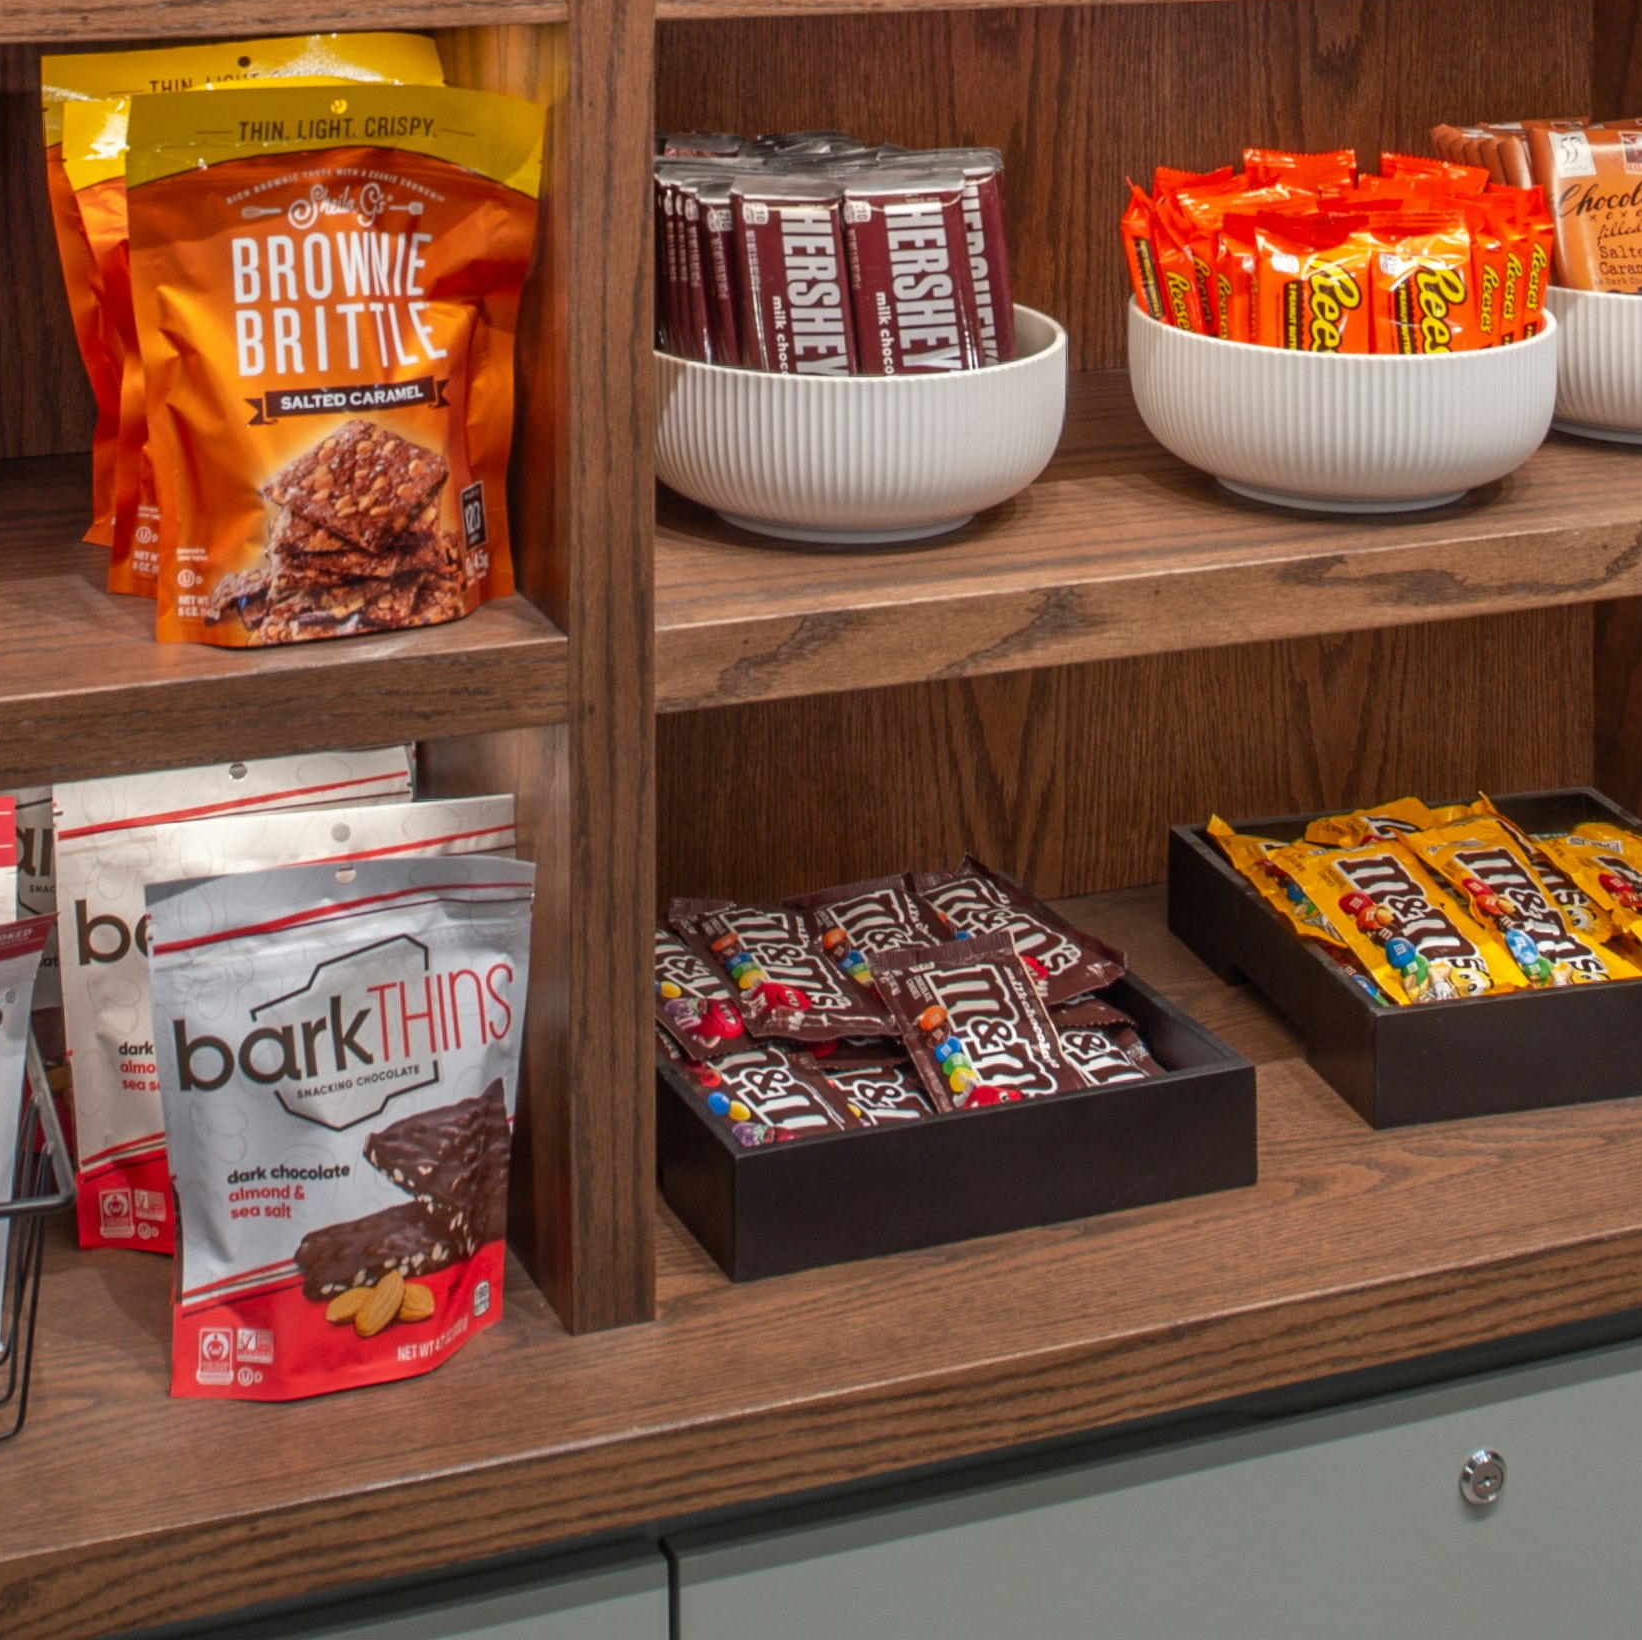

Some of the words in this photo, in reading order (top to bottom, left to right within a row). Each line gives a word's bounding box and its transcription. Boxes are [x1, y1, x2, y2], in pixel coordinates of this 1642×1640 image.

[238, 121, 291, 143] THIN.
[298, 118, 358, 141] LIGHT.
[365, 117, 438, 139] CRISPY.
[231, 232, 433, 304] BROWNIE
[1526, 242, 1547, 312] Reese's
[772, 295, 785, 328] milk
[875, 291, 887, 326] milk
[235, 302, 448, 377] BRITTLE
[280, 391, 348, 411] SALTED
[349, 384, 425, 407] CARAMEL
[118, 1040, 154, 1057] dark
[296, 1077, 354, 1100] SNACKING
[356, 1064, 422, 1086] CHOCOLATE
[227, 1165, 267, 1185] dark
[270, 1161, 352, 1182] chocolate
[228, 1183, 284, 1203] almond
[287, 1184, 306, 1200] &
[230, 1203, 260, 1219] sea
[265, 1202, 292, 1219] salt
